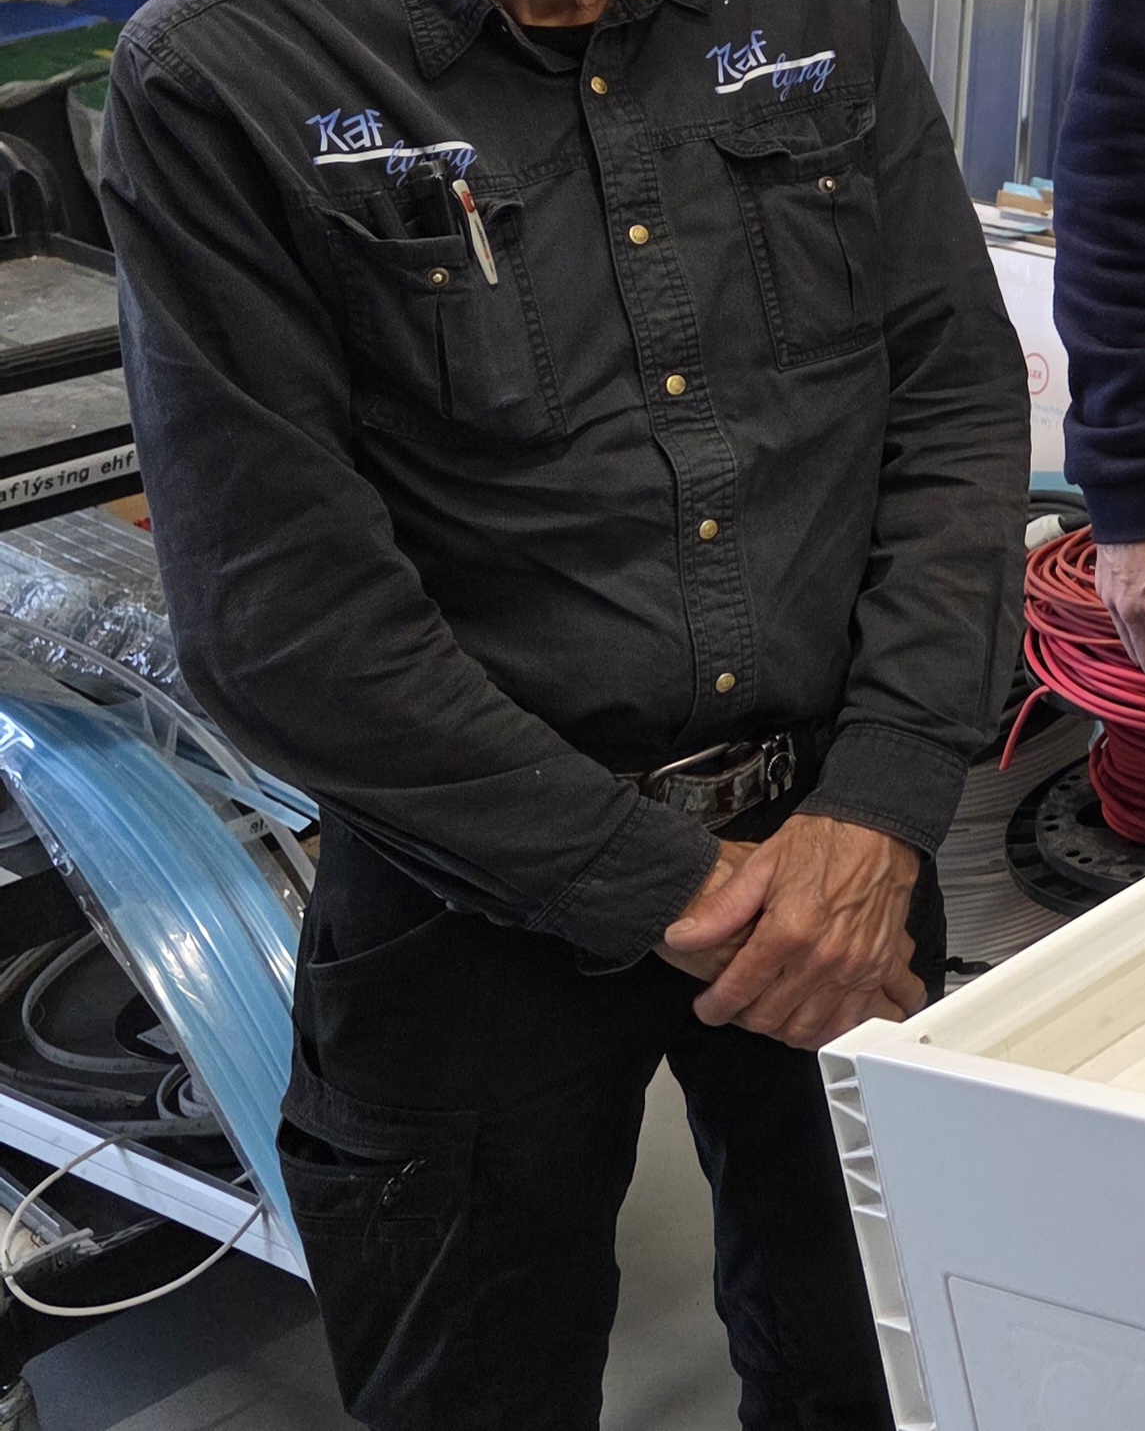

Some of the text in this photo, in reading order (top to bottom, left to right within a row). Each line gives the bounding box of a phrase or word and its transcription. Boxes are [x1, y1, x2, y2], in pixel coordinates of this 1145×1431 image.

[705, 30, 767, 83] Raf
[305, 108, 383, 152] Raf
[101, 450, 135, 475] ehf
